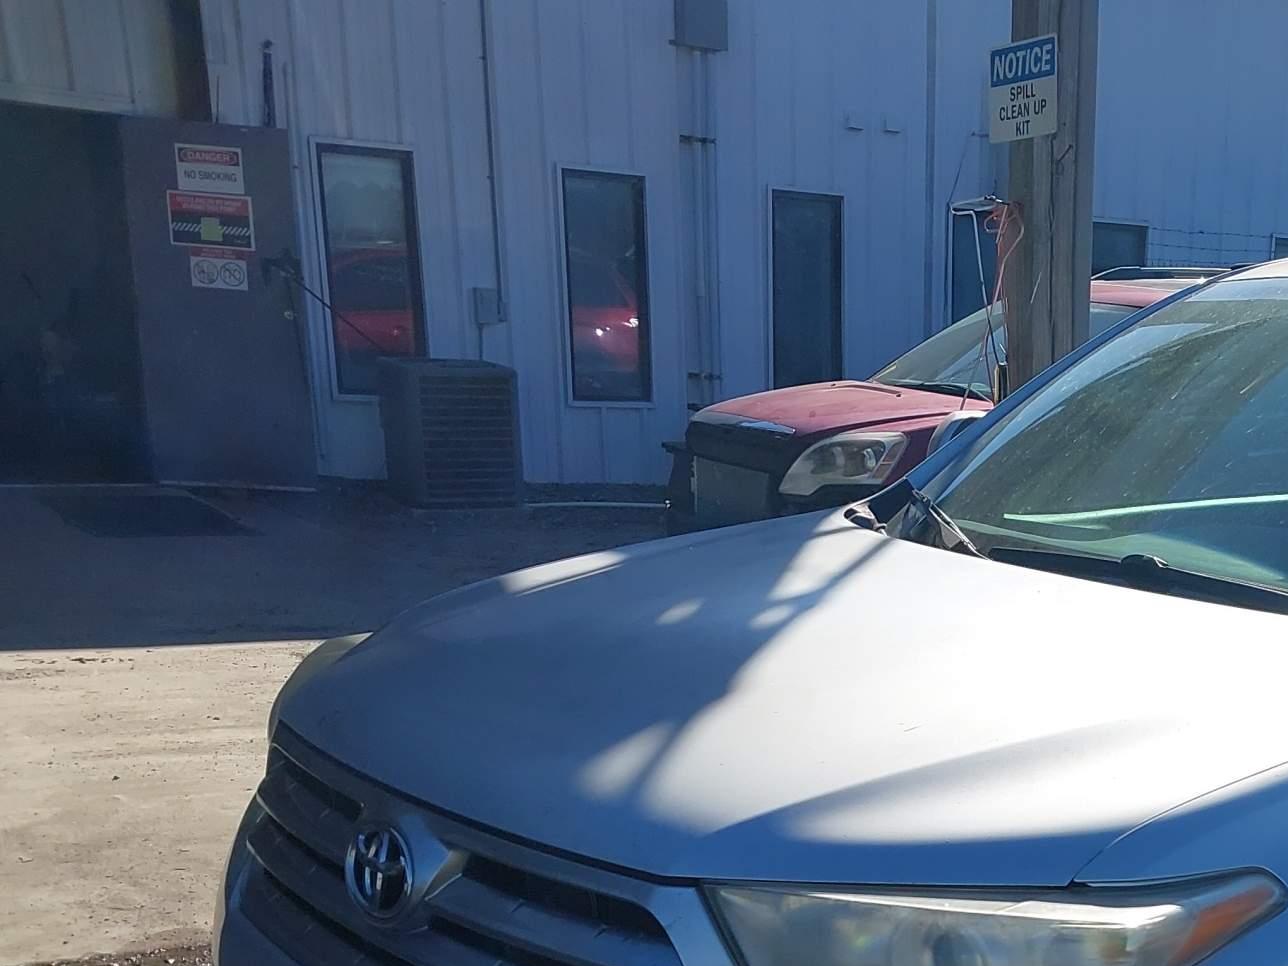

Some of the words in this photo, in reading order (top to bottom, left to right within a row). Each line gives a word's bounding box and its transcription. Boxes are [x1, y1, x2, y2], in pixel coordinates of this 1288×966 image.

[993, 43, 1052, 82] NOTICE
[1009, 82, 1036, 102] SPILL
[999, 101, 1030, 121] CLEAN
[1033, 98, 1047, 115] UP
[1015, 119, 1031, 137] KIT
[187, 151, 232, 163] DANGER
[184, 169, 196, 180] NO
[198, 170, 238, 183] SMOKING
